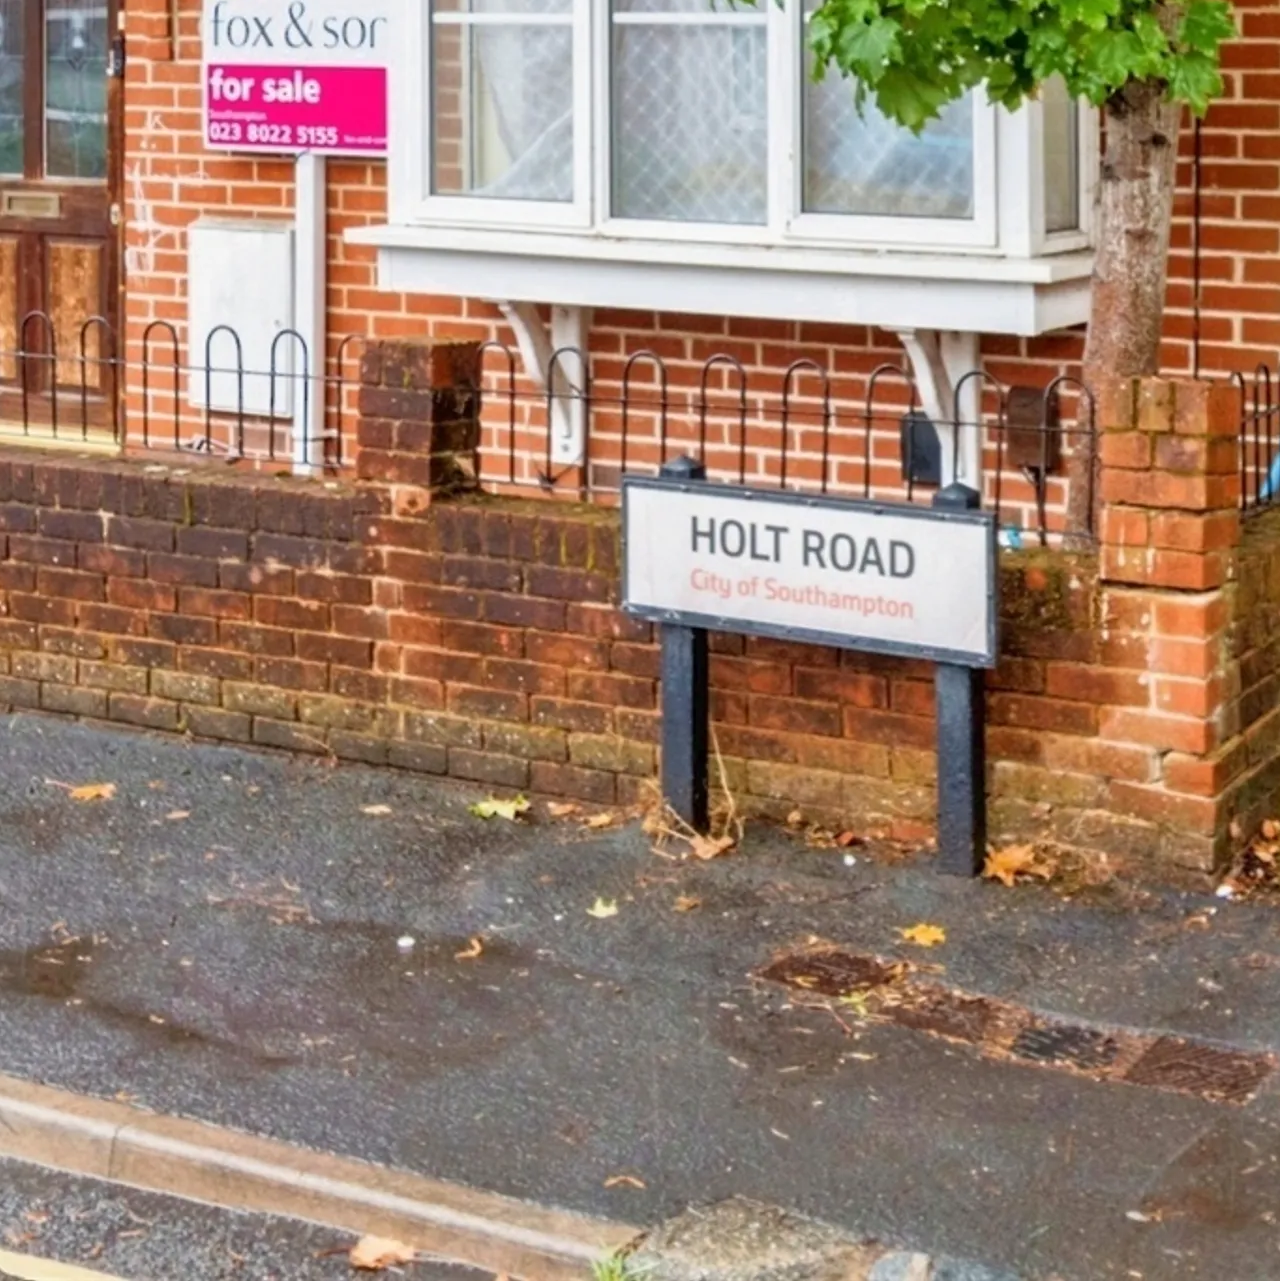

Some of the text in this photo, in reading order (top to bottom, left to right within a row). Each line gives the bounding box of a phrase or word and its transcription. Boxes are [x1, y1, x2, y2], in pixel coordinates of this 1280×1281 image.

[212, 1, 274, 47] fox
[284, 1, 313, 48] &
[209, 68, 321, 104] for sale
[210, 122, 241, 141] 023
[247, 124, 291, 143] 8022
[297, 126, 338, 145] 5155
[691, 516, 915, 579] HOLT ROAD
[690, 568, 914, 619] City of Southampton
